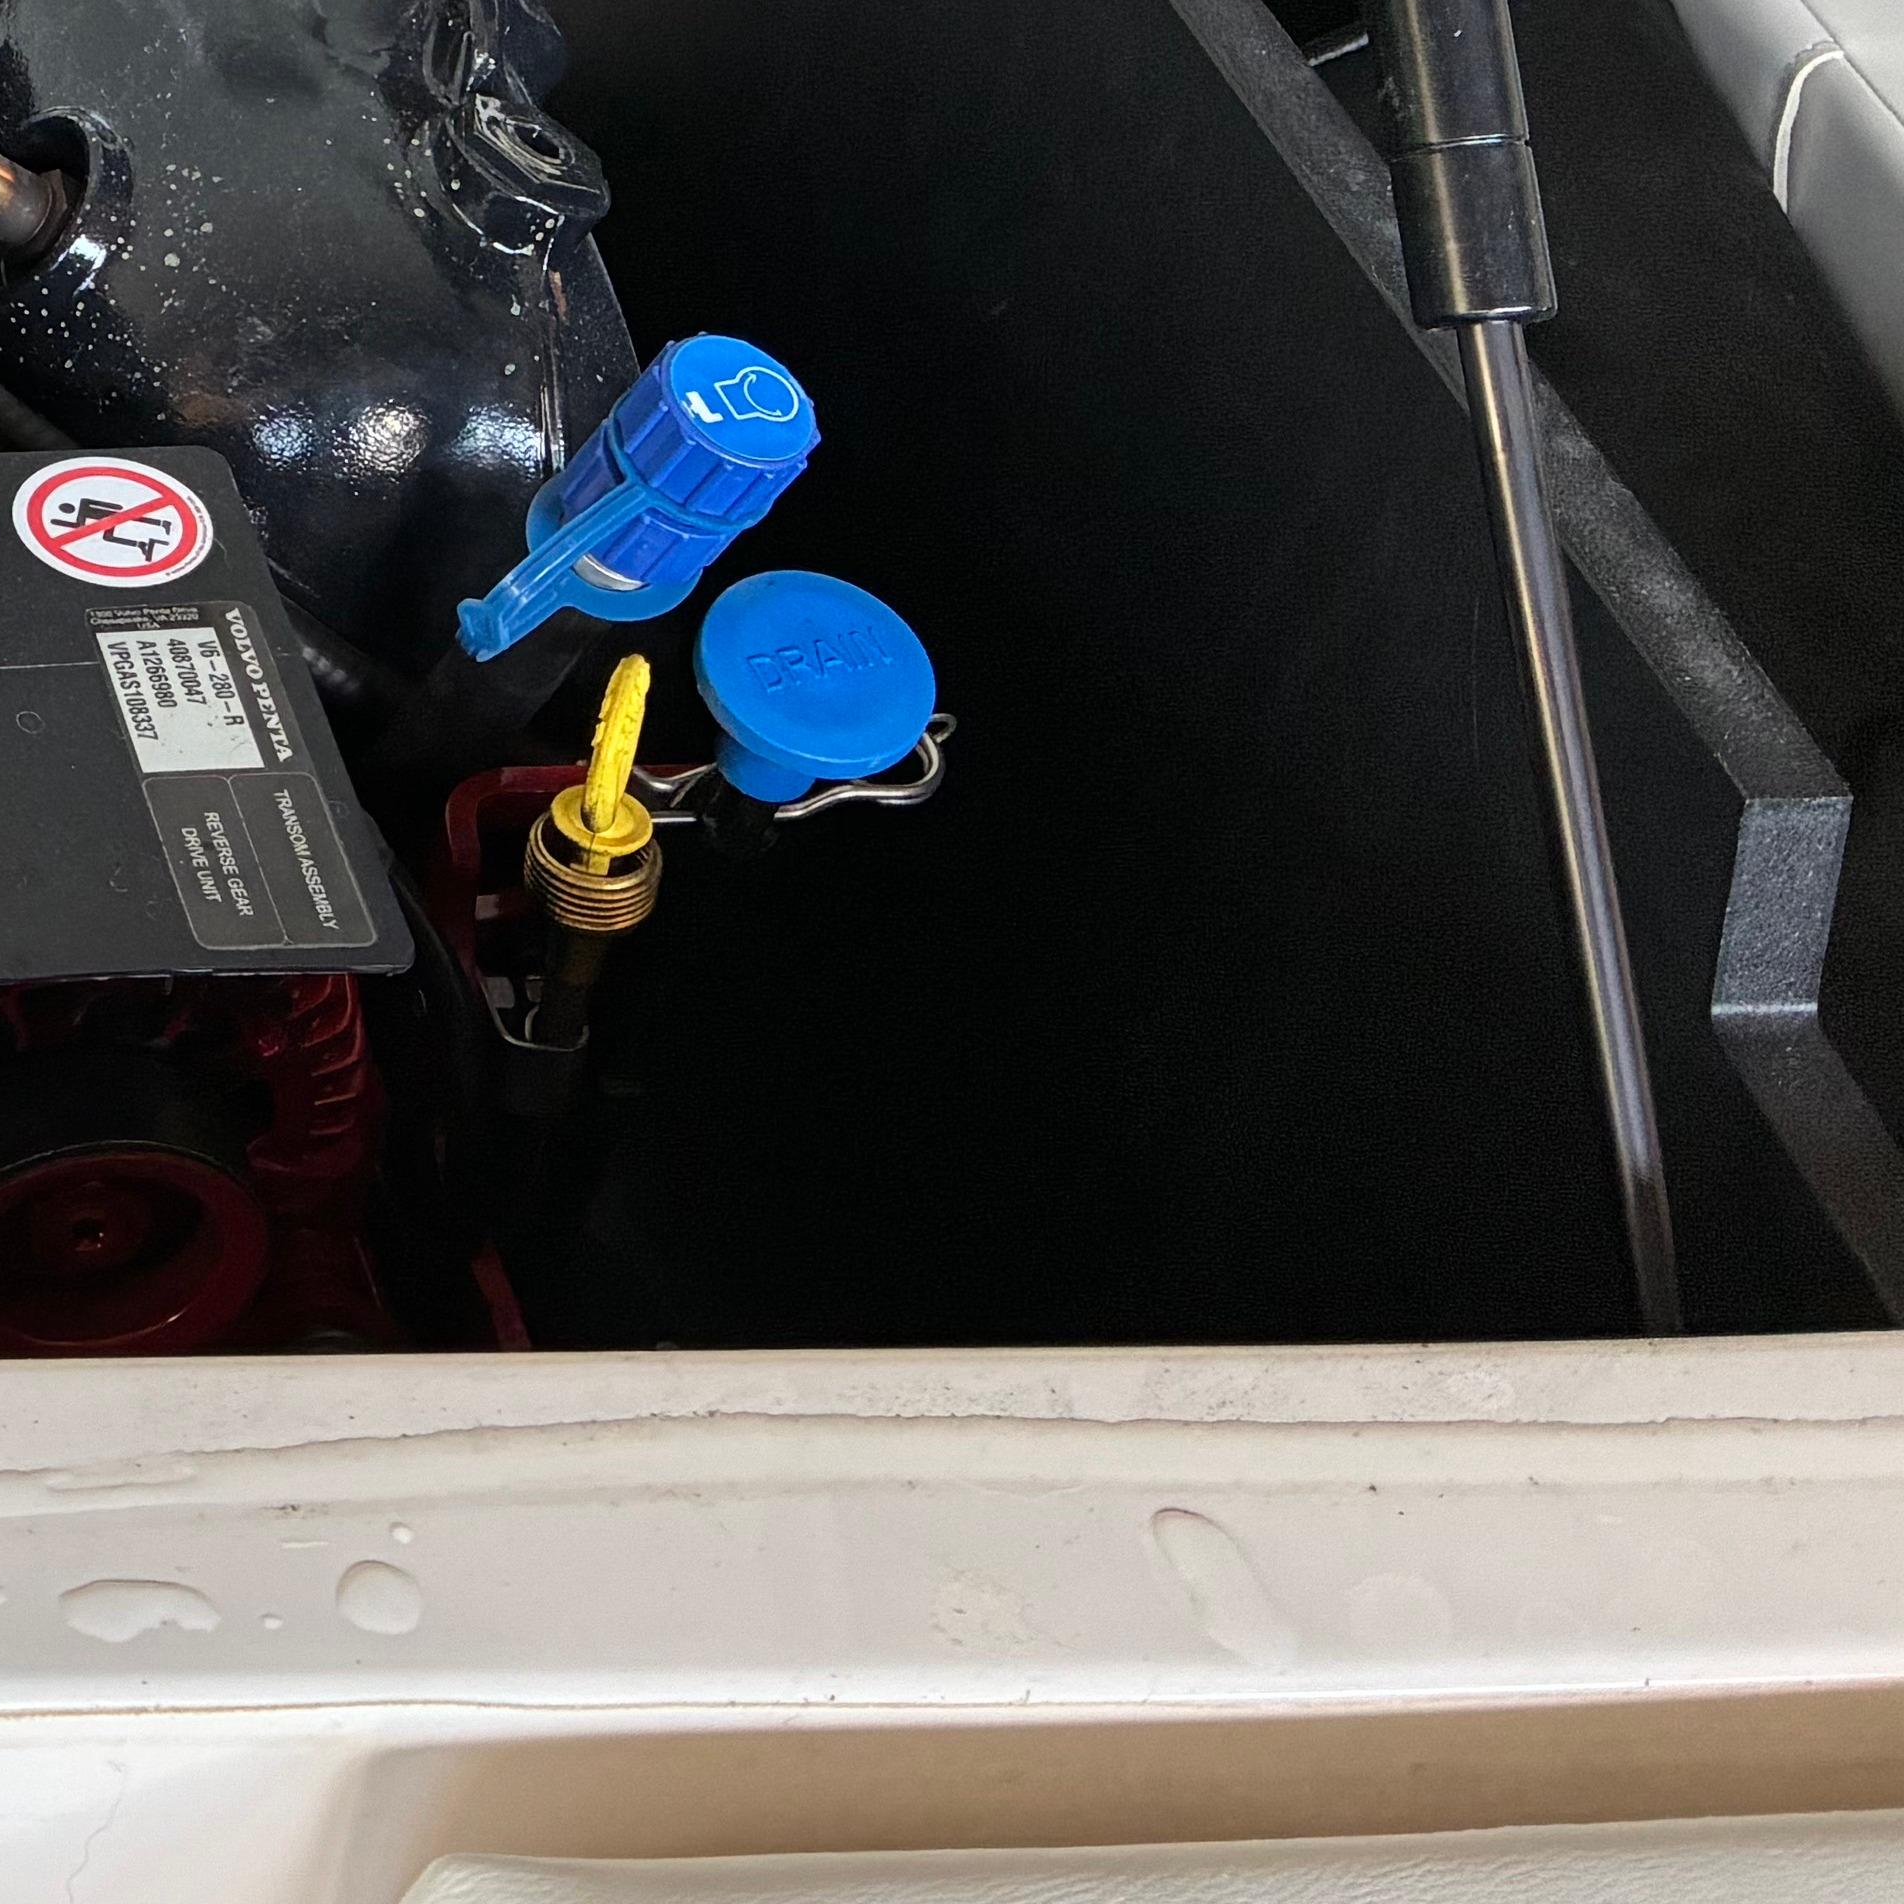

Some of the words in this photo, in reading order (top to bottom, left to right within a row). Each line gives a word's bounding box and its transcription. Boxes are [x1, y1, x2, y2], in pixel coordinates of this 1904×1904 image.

[107, 641, 159, 741] VPGAS108337
[136, 640, 178, 709] A1266980
[167, 638, 207, 705] 40870047
[224, 608, 264, 680] VOLVO
[252, 681, 293, 762] PENTA
[747, 624, 894, 694] DRAIN
[181, 827, 209, 868] DRIVE
[196, 870, 222, 903] UNIT
[204, 812, 240, 875] REVERSE
[227, 878, 254, 916] GEAR
[273, 789, 311, 856] TRANSOM
[298, 857, 340, 930] ASSEMBLY
